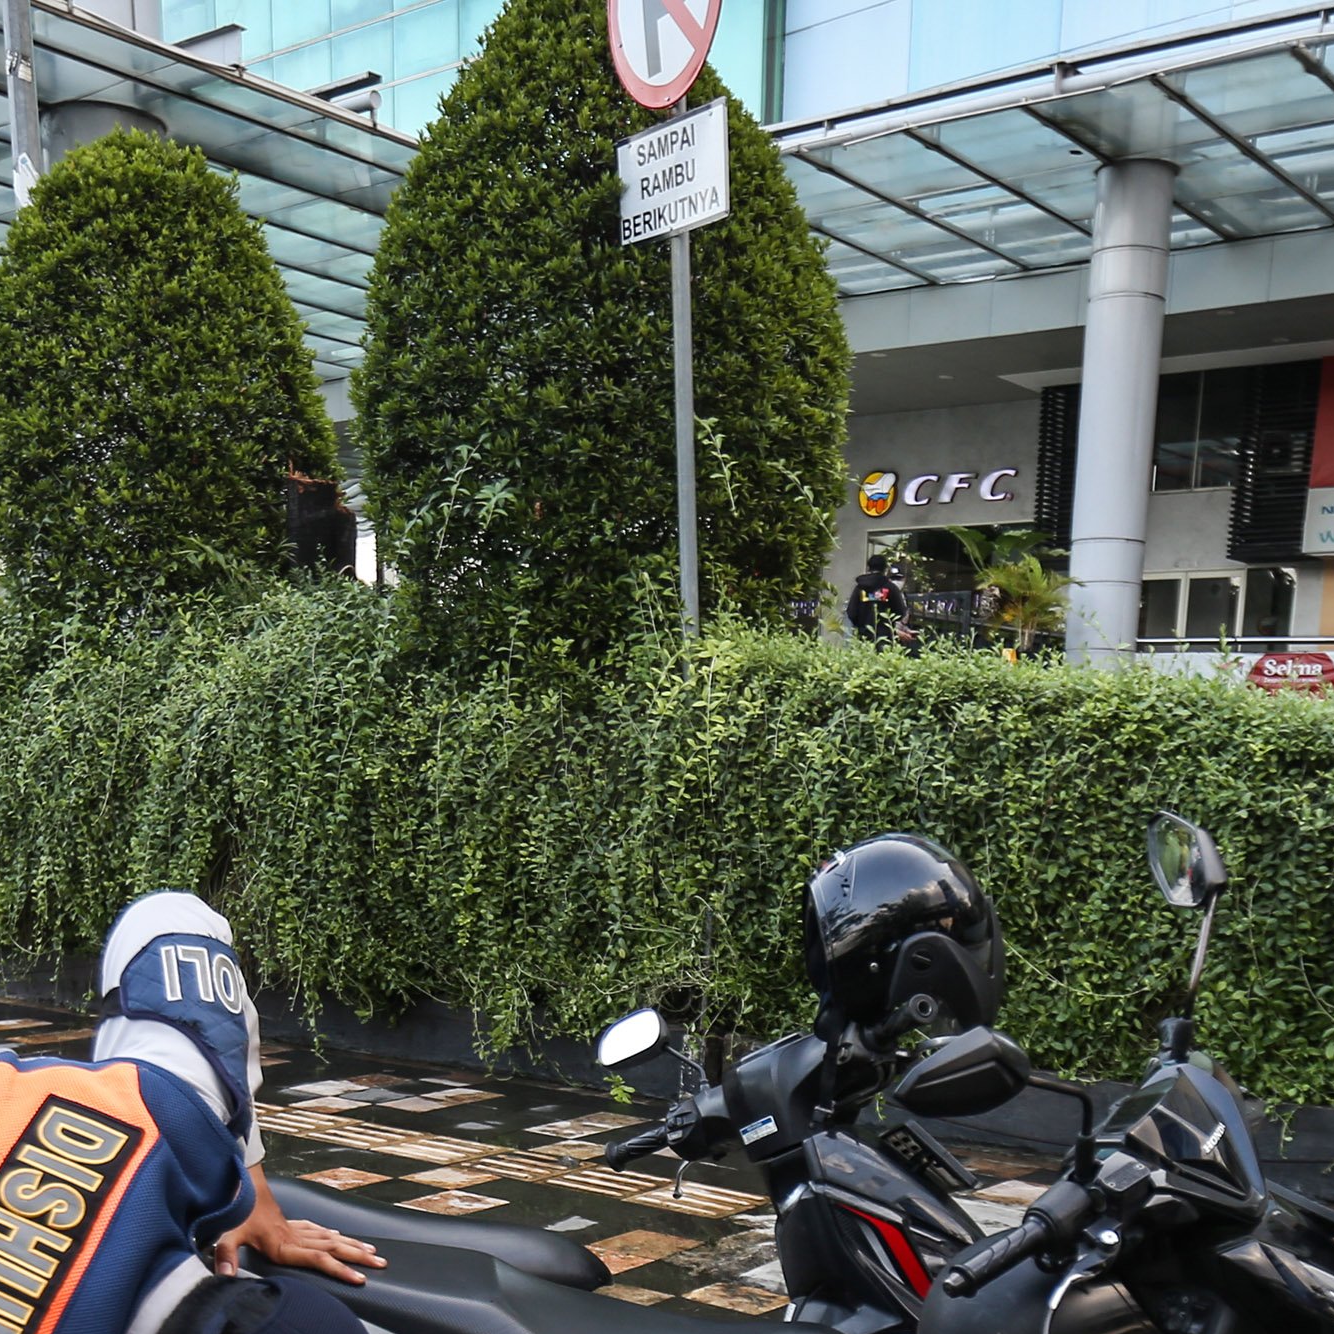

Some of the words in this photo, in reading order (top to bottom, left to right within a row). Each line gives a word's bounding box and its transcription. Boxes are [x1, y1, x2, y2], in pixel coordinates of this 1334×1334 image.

[637, 123, 696, 167] SAMPAI
[640, 158, 696, 200] RAMBU
[622, 186, 720, 241] BERIKUTNYA
[903, 469, 1019, 506] CFC
